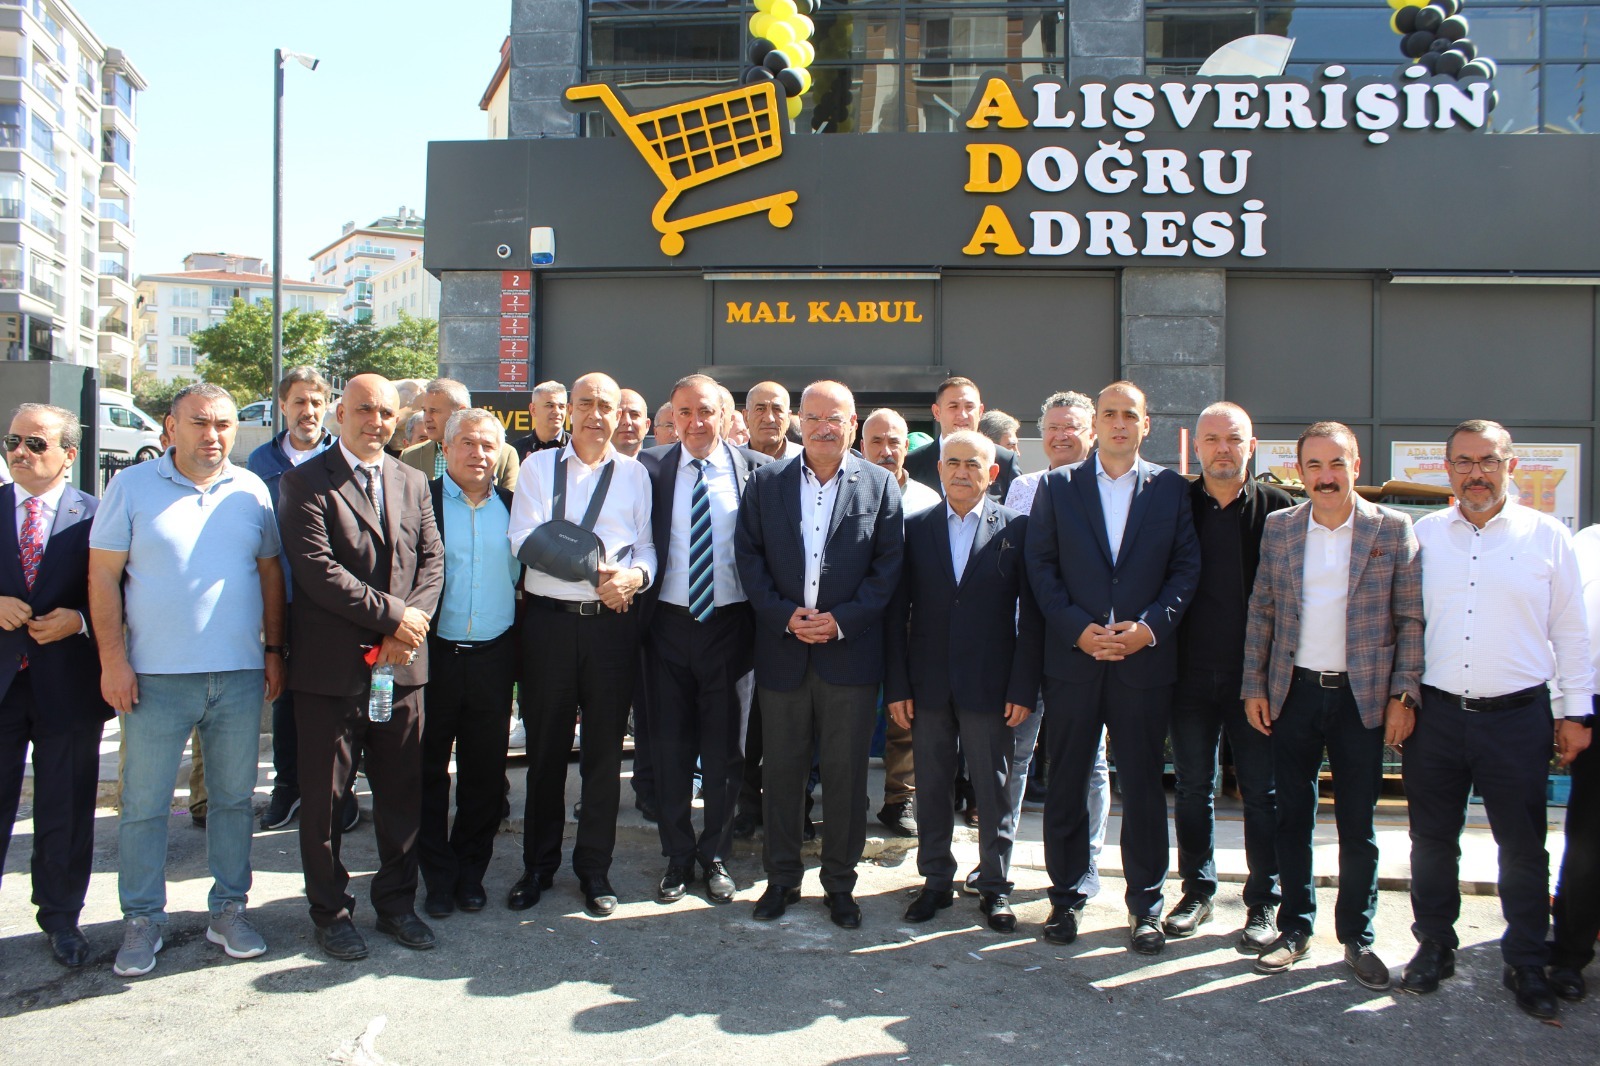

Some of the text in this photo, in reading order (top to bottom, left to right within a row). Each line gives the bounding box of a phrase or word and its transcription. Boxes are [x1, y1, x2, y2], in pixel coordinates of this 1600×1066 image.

[965, 65, 1490, 144] ALIŞVERİŞİN
[964, 140, 1253, 195] DOĞRU
[962, 199, 1267, 258] ADRESİ
[512, 275, 520, 287] 2
[513, 295, 519, 304] 2
[726, 301, 923, 324] MAL KABUL
[512, 318, 518, 327] 2
[511, 341, 517, 350] 2
[511, 364, 516, 373] 2
[1407, 447, 1428, 456] ADA
